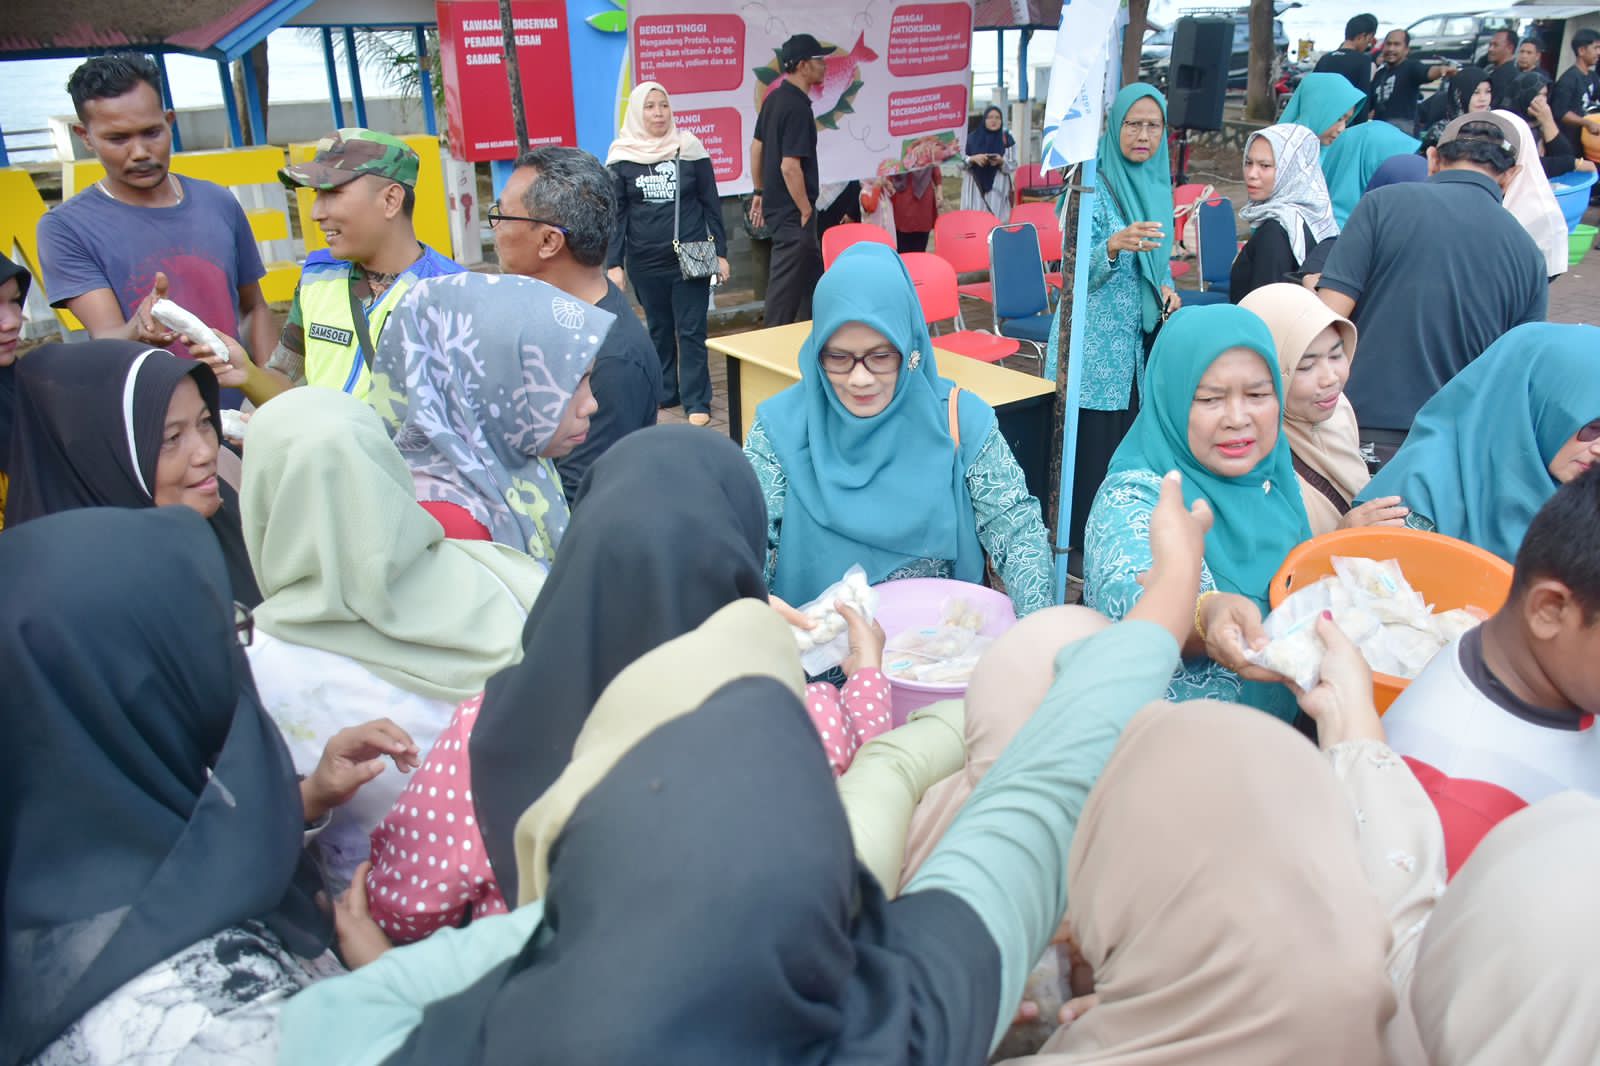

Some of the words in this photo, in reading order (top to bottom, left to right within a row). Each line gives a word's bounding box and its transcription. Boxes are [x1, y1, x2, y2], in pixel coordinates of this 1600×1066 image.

[463, 19, 502, 31] KAWASA
[512, 18, 558, 29] ONSERVASI
[639, 25, 674, 34] BERGIZI
[676, 24, 707, 32] TINGGI
[464, 36, 504, 48] PERAIRA
[514, 35, 541, 46] AERAH
[640, 38, 683, 48] Mengandung
[640, 50, 664, 59] minyak
[665, 48, 680, 56] ikan
[681, 47, 706, 55] vitamin
[466, 54, 501, 65] SABANG
[710, 57, 724, 65] dan
[674, 114, 701, 124] RANGI
[311, 326, 348, 342] SAMSOEL
